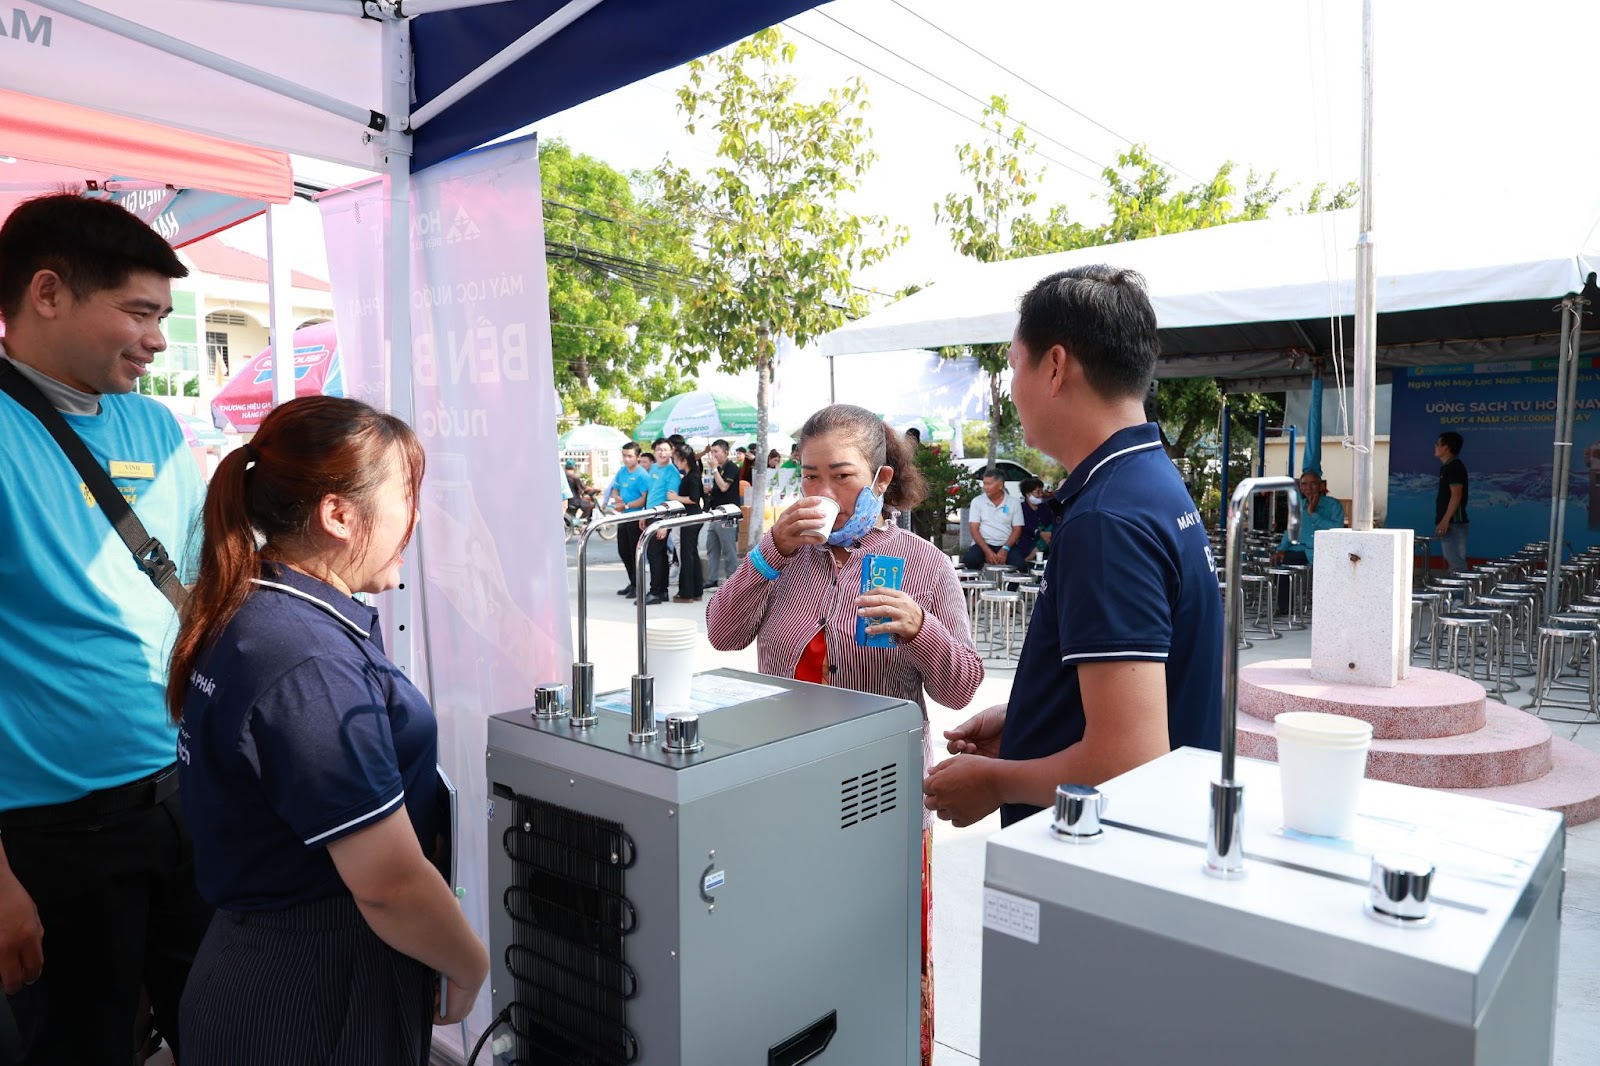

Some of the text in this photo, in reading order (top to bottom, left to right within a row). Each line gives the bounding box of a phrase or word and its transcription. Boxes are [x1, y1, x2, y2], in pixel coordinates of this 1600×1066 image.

[1469, 401, 1508, 415] SẠCH
[1468, 416, 1475, 424] 4
[1177, 511, 1196, 531] MÁY
[195, 673, 217, 697] PHÁT
